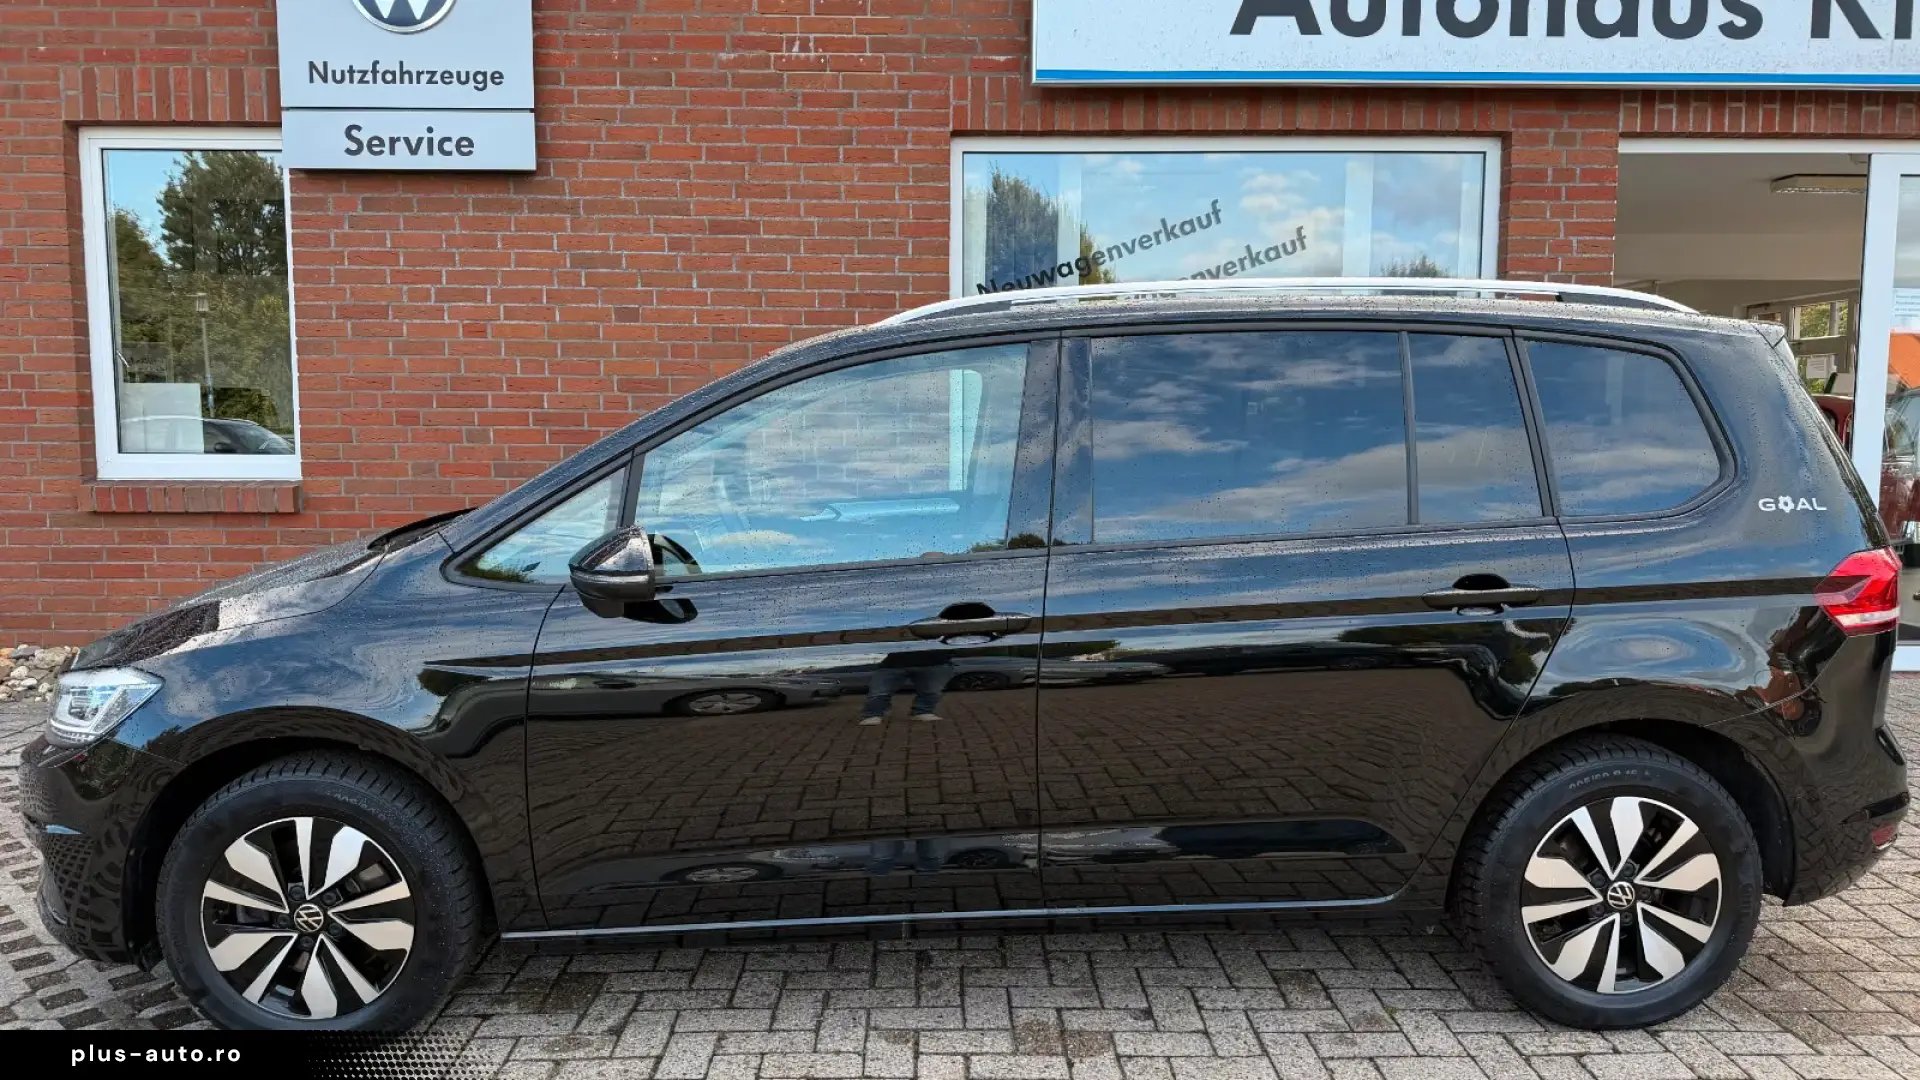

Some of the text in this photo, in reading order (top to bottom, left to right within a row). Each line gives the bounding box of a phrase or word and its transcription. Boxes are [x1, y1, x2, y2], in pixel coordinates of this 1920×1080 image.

[307, 60, 505, 91] Nutzfahrzeuge
[343, 124, 475, 157] Service
[1758, 495, 1827, 513] GOAL
